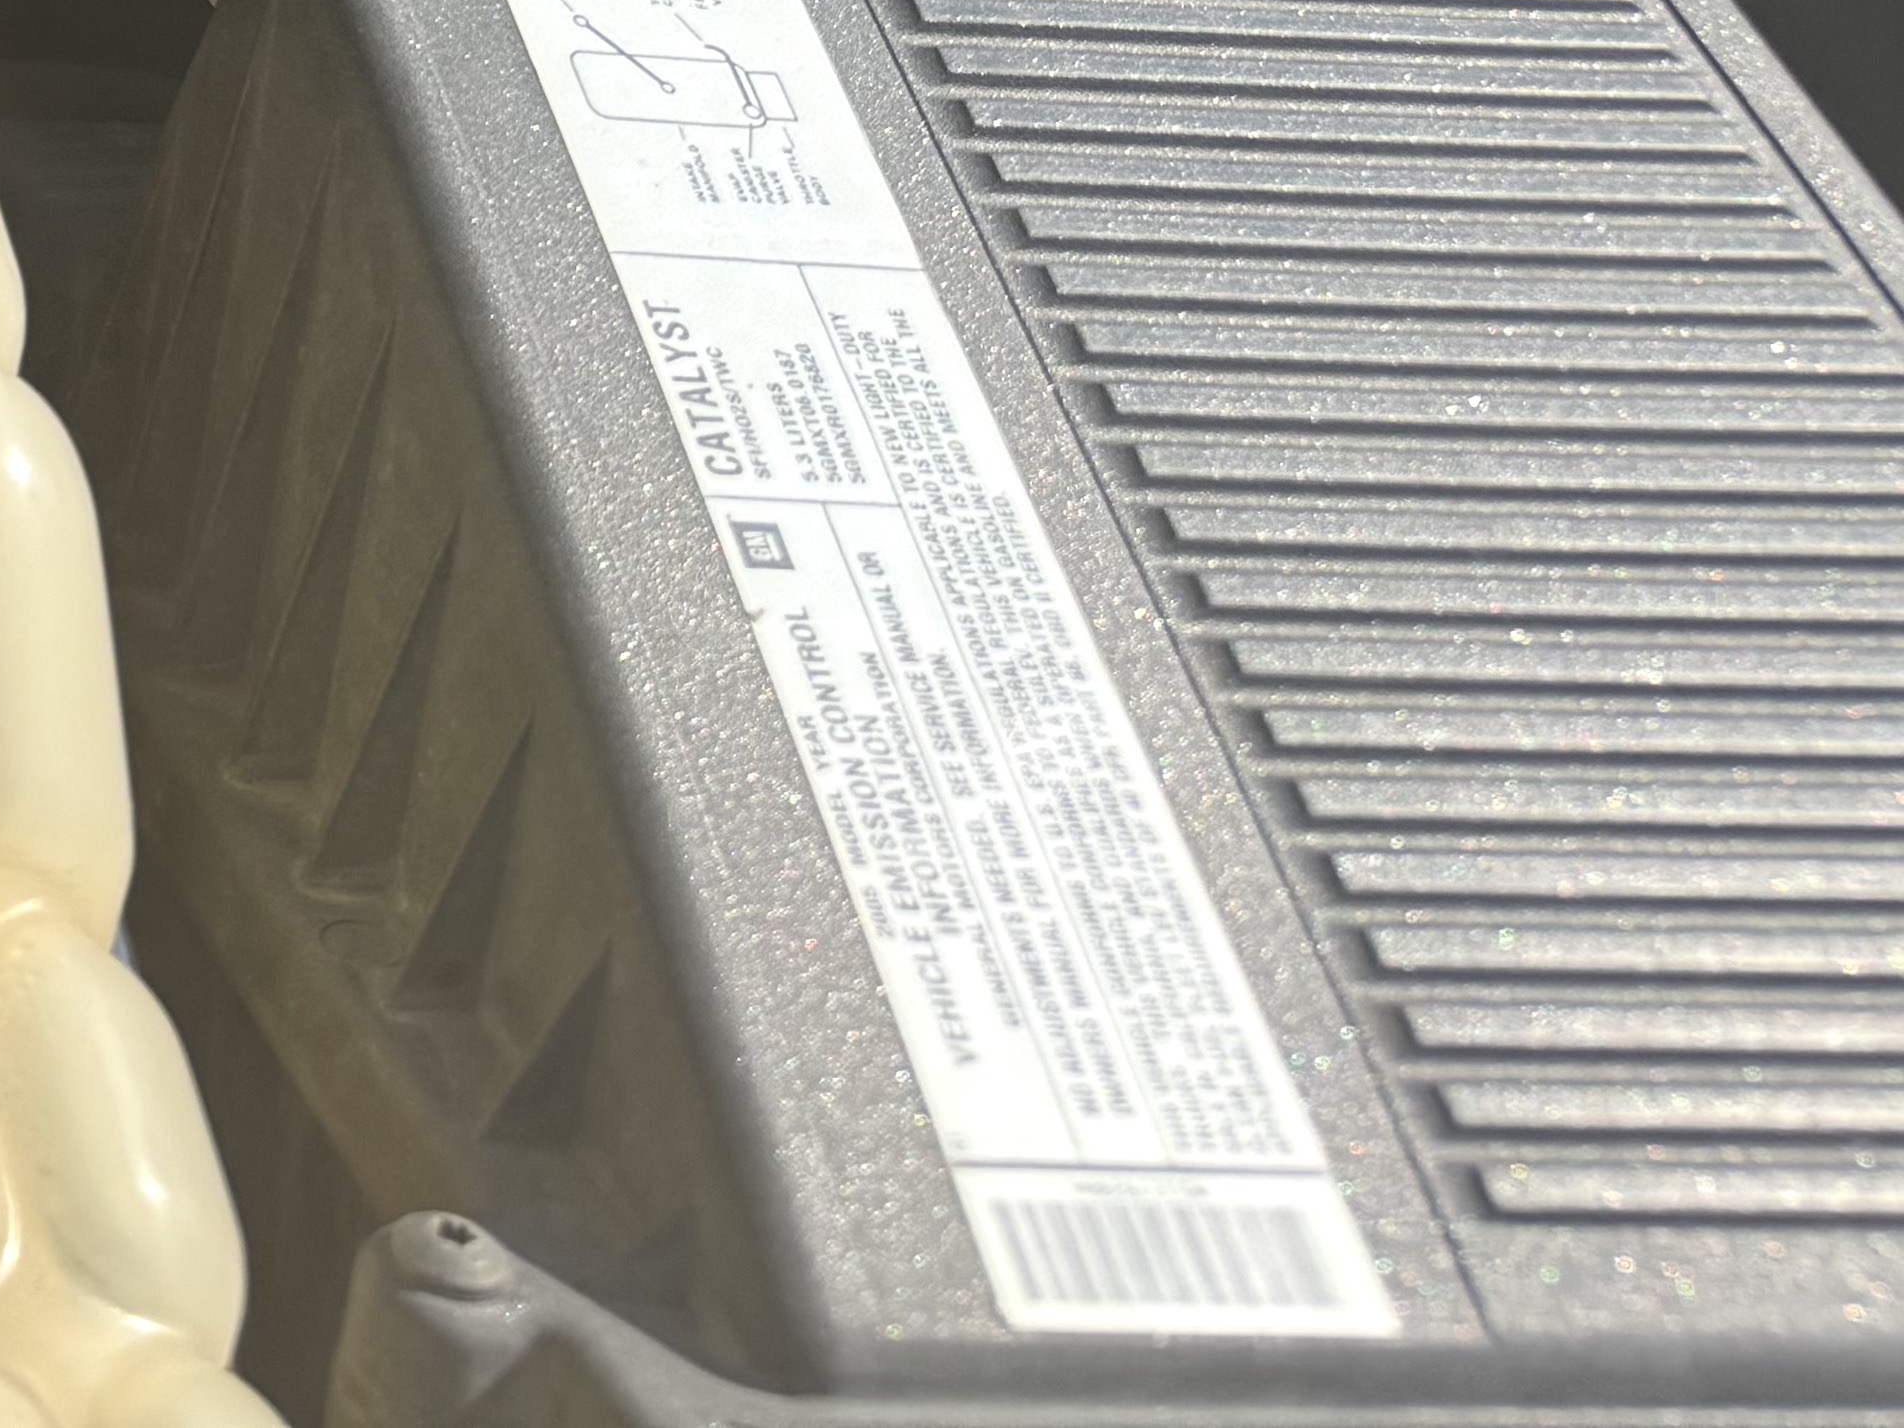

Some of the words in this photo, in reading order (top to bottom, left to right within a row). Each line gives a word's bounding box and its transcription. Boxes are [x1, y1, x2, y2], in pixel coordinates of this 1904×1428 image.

[857, 330, 887, 363] FOR
[880, 336, 908, 367] THE
[888, 307, 916, 338] THE
[640, 298, 746, 476] CATALYST
[896, 373, 920, 394] TO
[904, 344, 931, 373] ALL
[765, 381, 806, 446] LITERS
[873, 368, 924, 452] CERTIFIED
[919, 379, 958, 434] MEETS
[874, 424, 908, 464] NEW
[907, 400, 960, 486] CERTIFIED
[945, 439, 976, 476] AND
[894, 471, 920, 492] TO
[920, 480, 952, 516] AND
[853, 550, 885, 575] OR
[866, 583, 920, 662] MANUAL
[778, 605, 857, 743] CONTROL
[856, 650, 934, 805] CORPORATION
[901, 670, 957, 752] SERVICE
[794, 714, 832, 770] YEAR
[938, 760, 975, 798] SEE
[822, 791, 868, 865] MODEL
[836, 756, 922, 910] EMISSION
[852, 713, 963, 935] INFORMATION
[921, 813, 976, 910] MOTORS
[900, 925, 982, 1066] VEHICLE
